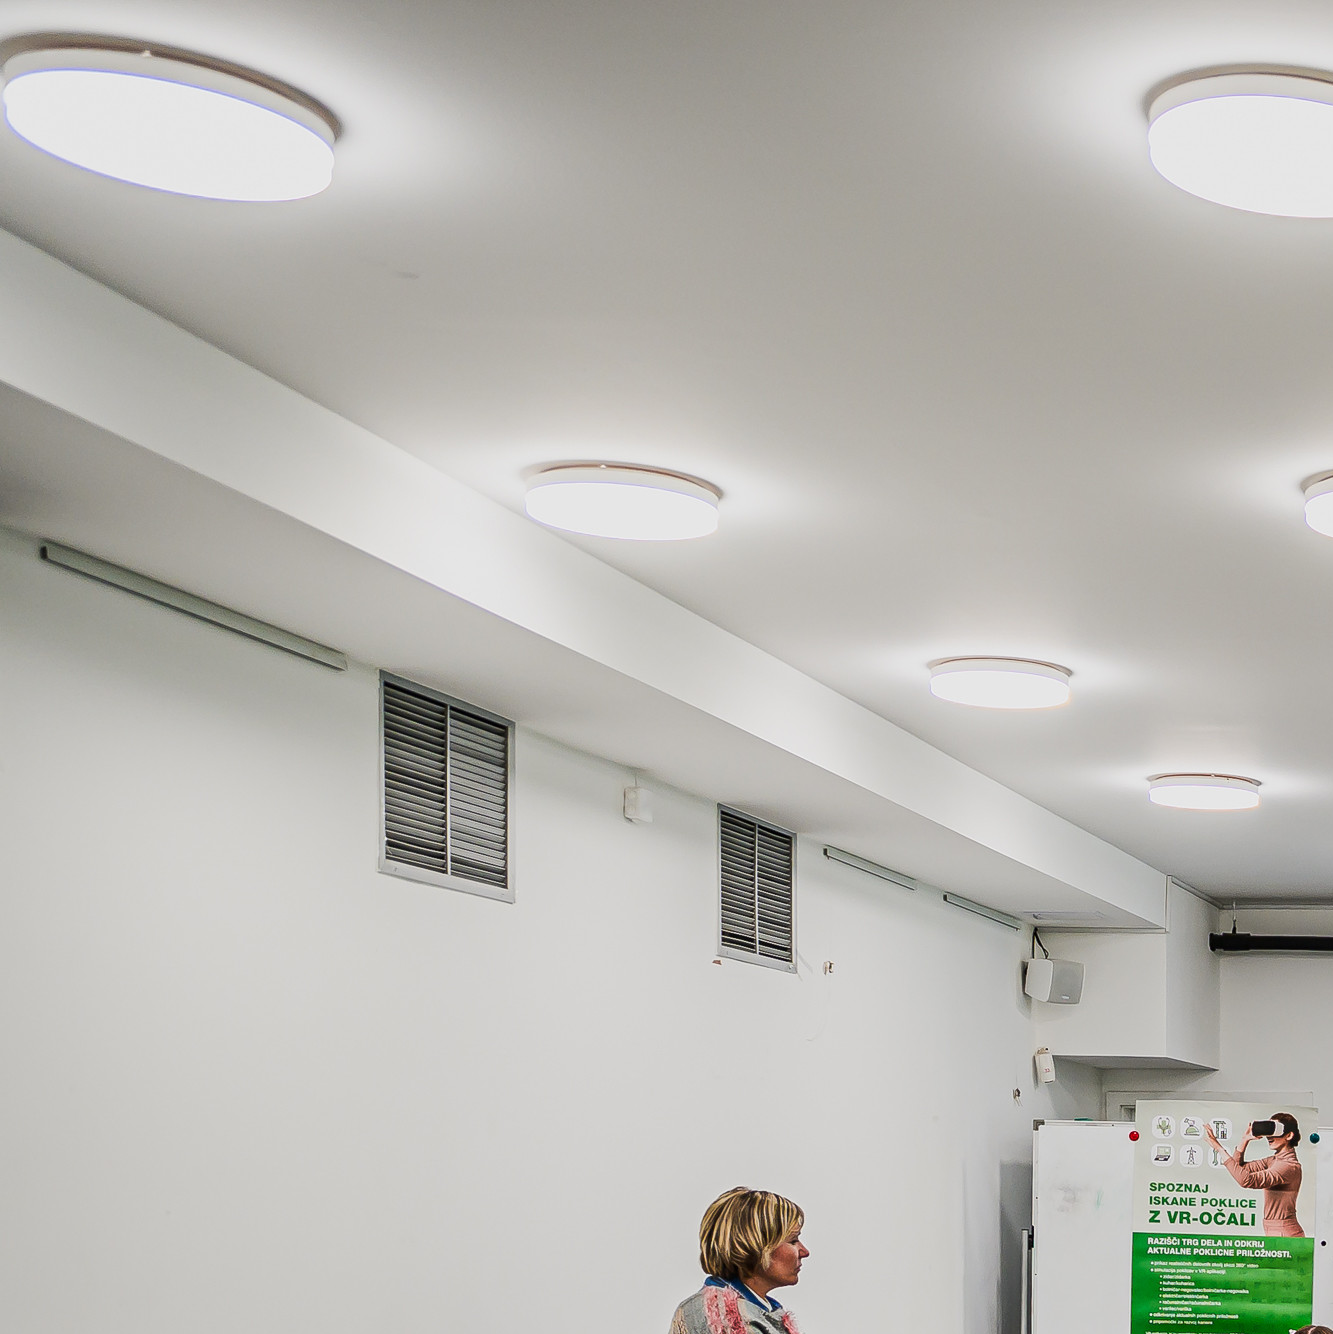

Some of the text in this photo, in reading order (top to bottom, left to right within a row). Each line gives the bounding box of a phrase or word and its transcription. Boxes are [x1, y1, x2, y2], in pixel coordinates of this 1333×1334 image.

[1149, 1182, 1208, 1193] SPOZNAJ
[1149, 1196, 1256, 1208] ISKANE POKLICE
[1148, 1209, 1255, 1226] Z VR-OČALI
[1147, 1237, 1180, 1245] RAZIŠČI
[1182, 1238, 1199, 1246] TRG
[1224, 1239, 1232, 1247] IN
[1234, 1240, 1264, 1248] ODKRIJ
[1147, 1247, 1292, 1258] AKTUALNE POKLICNE PRILOŽNOSTI.
